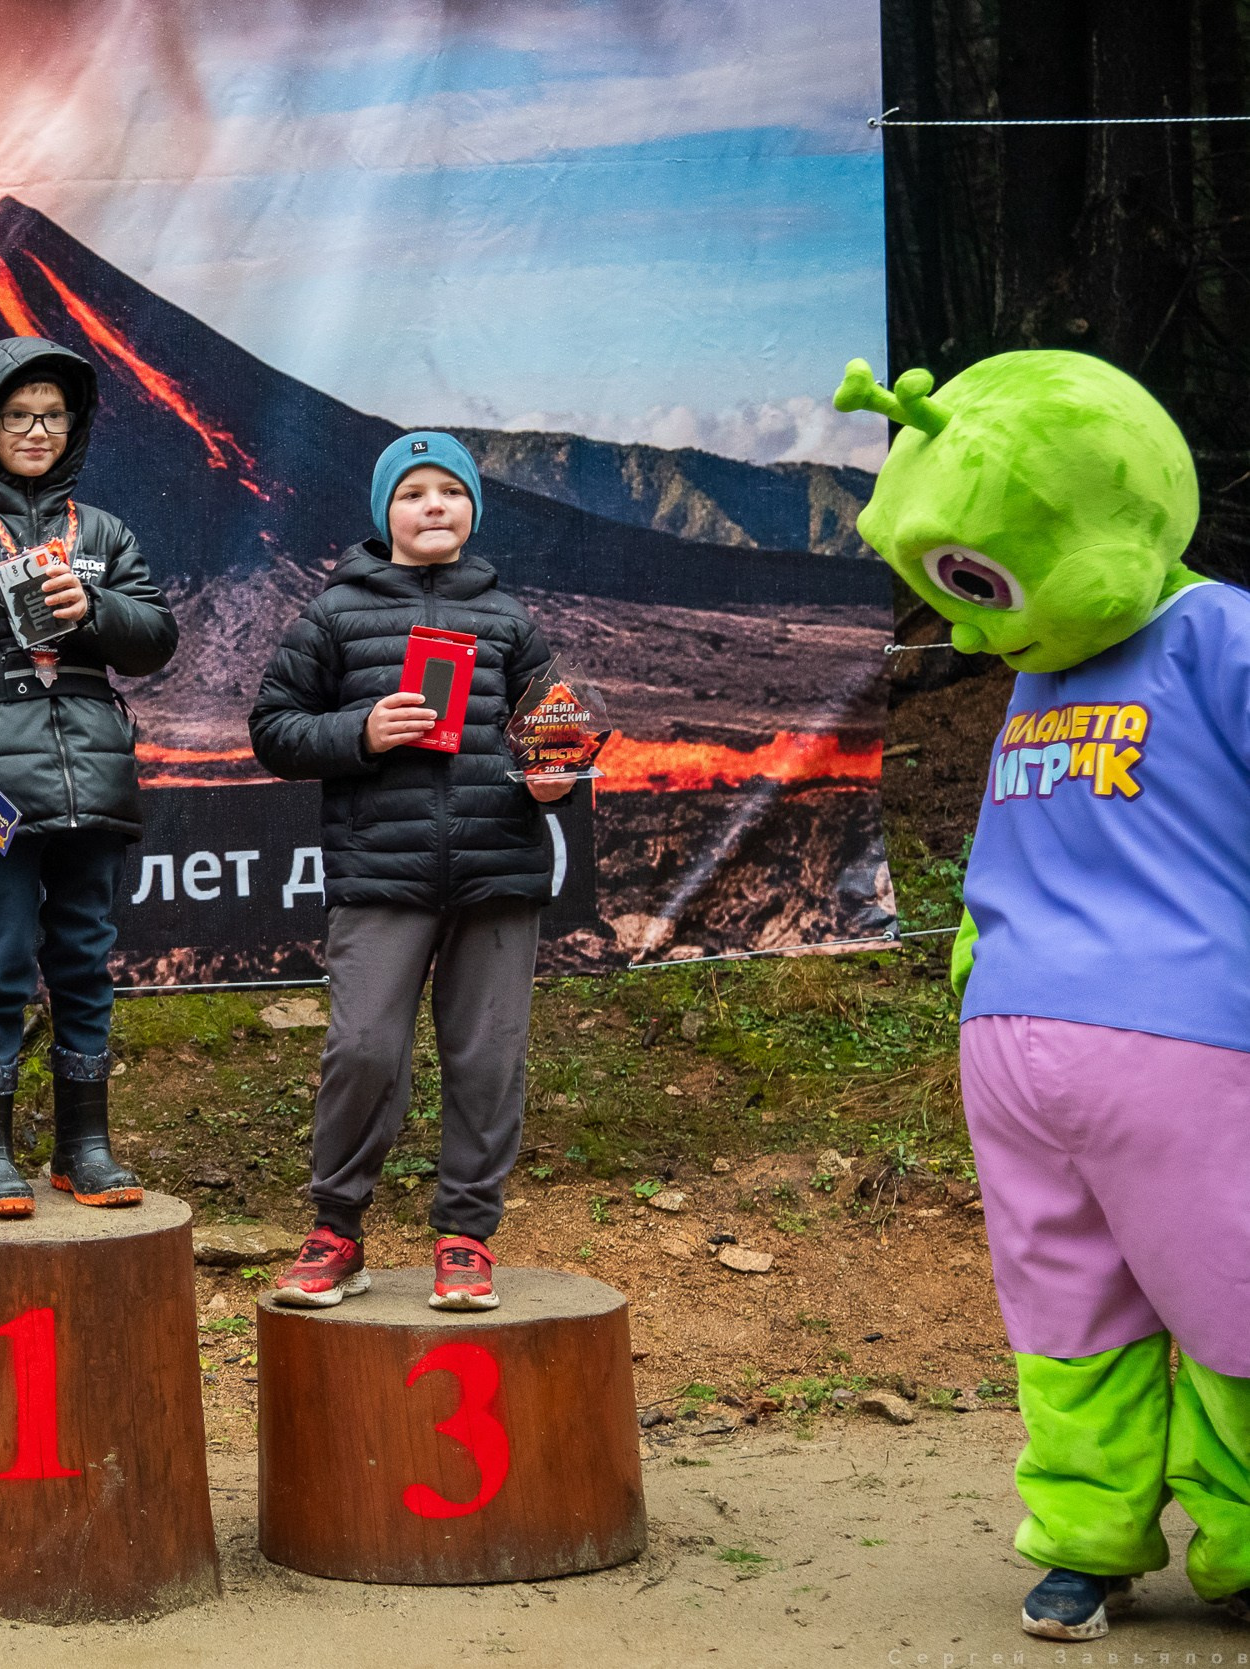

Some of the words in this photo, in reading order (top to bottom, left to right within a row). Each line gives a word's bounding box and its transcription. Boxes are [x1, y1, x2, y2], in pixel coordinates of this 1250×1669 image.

[540, 702, 575, 713] ТРЕЙЛ
[524, 710, 590, 724] УРАЛЬСКИЙ
[535, 723, 579, 734] ВУЛКАН
[1002, 704, 1149, 747] ПЛАНЕТА
[523, 736, 545, 745] ГОРА
[528, 750, 536, 760] 3
[539, 747, 583, 760] МЕСТО
[544, 765, 565, 773] 2026
[993, 742, 1142, 801] ИГРИК
[131, 850, 260, 905] лет
[404, 1344, 509, 1518] 3
